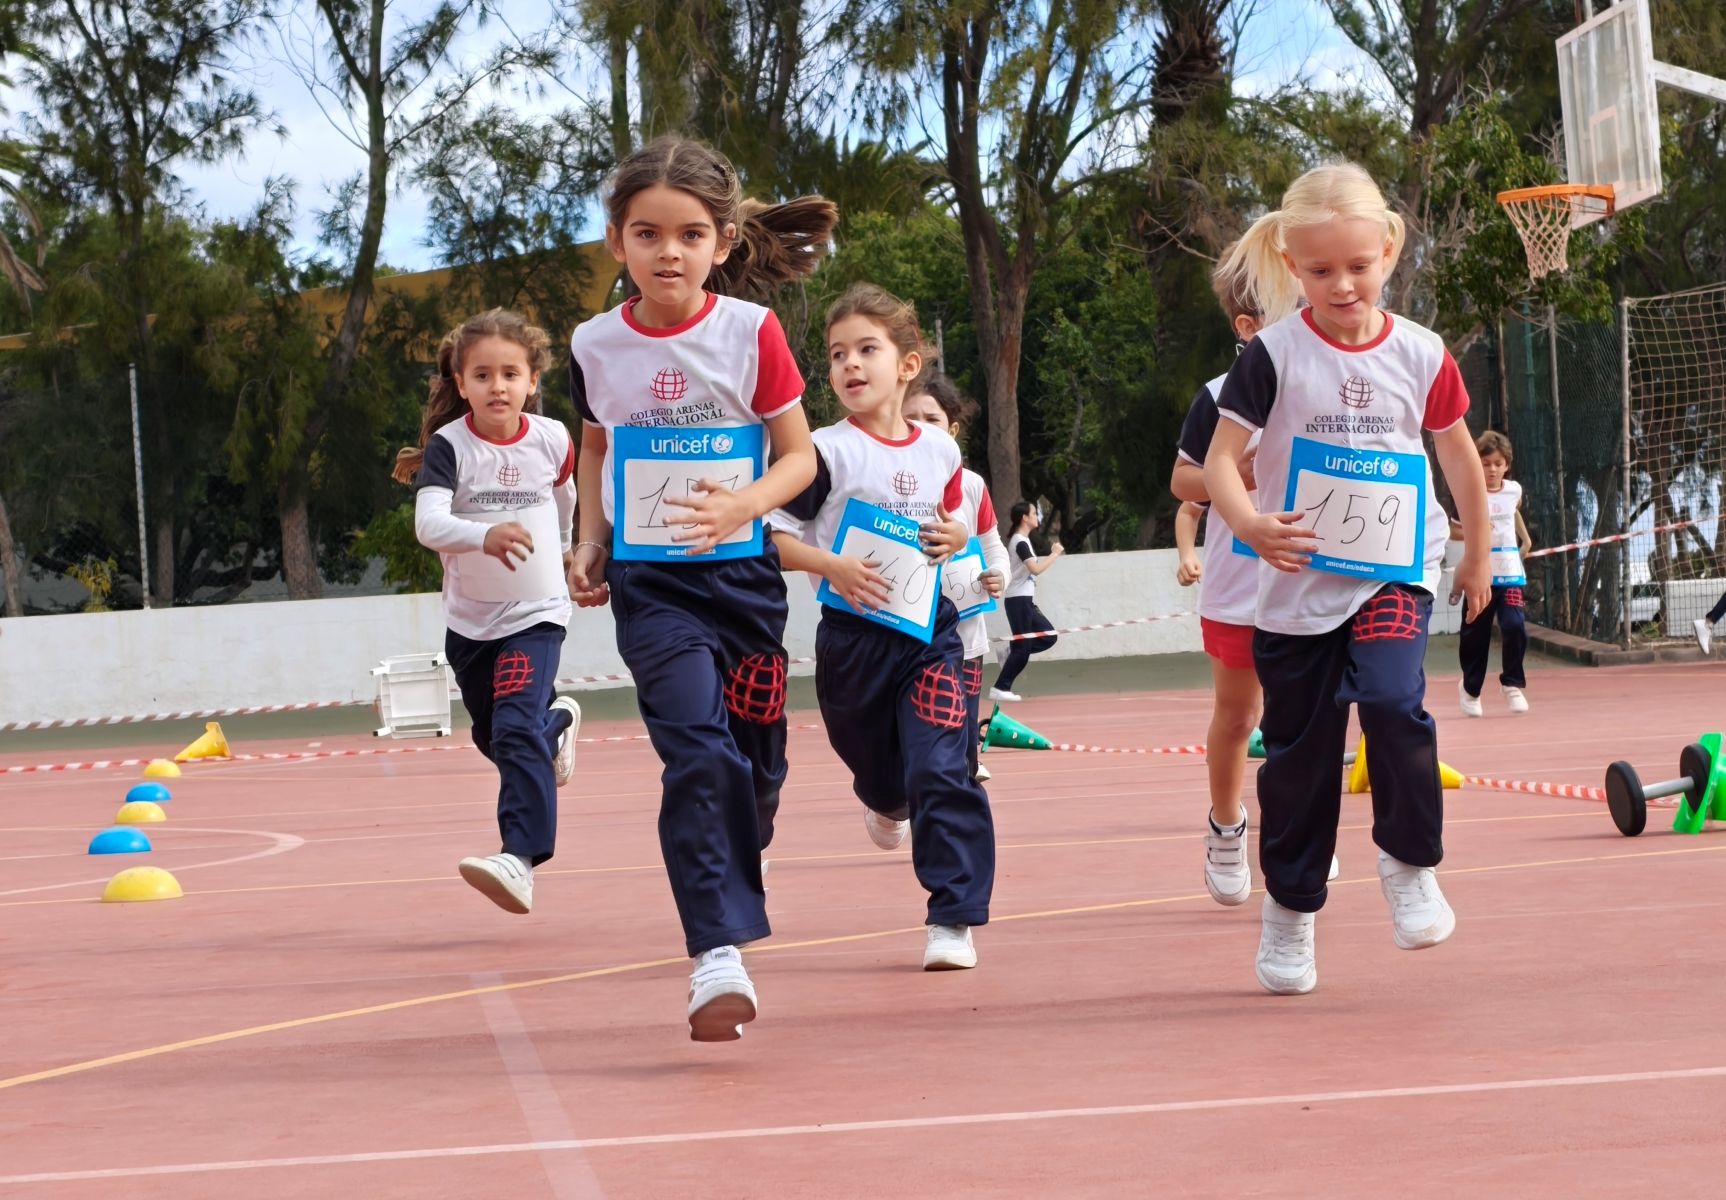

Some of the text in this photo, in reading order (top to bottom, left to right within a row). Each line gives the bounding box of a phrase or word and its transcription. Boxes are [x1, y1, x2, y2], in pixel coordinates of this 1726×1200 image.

[630, 401, 715, 421] COLEGIO ARENAS
[1314, 415, 1395, 424] COLEGIO ARENAS
[651, 434, 710, 454] unicef
[1325, 454, 1380, 475] unicef
[1305, 489, 1401, 551] 159
